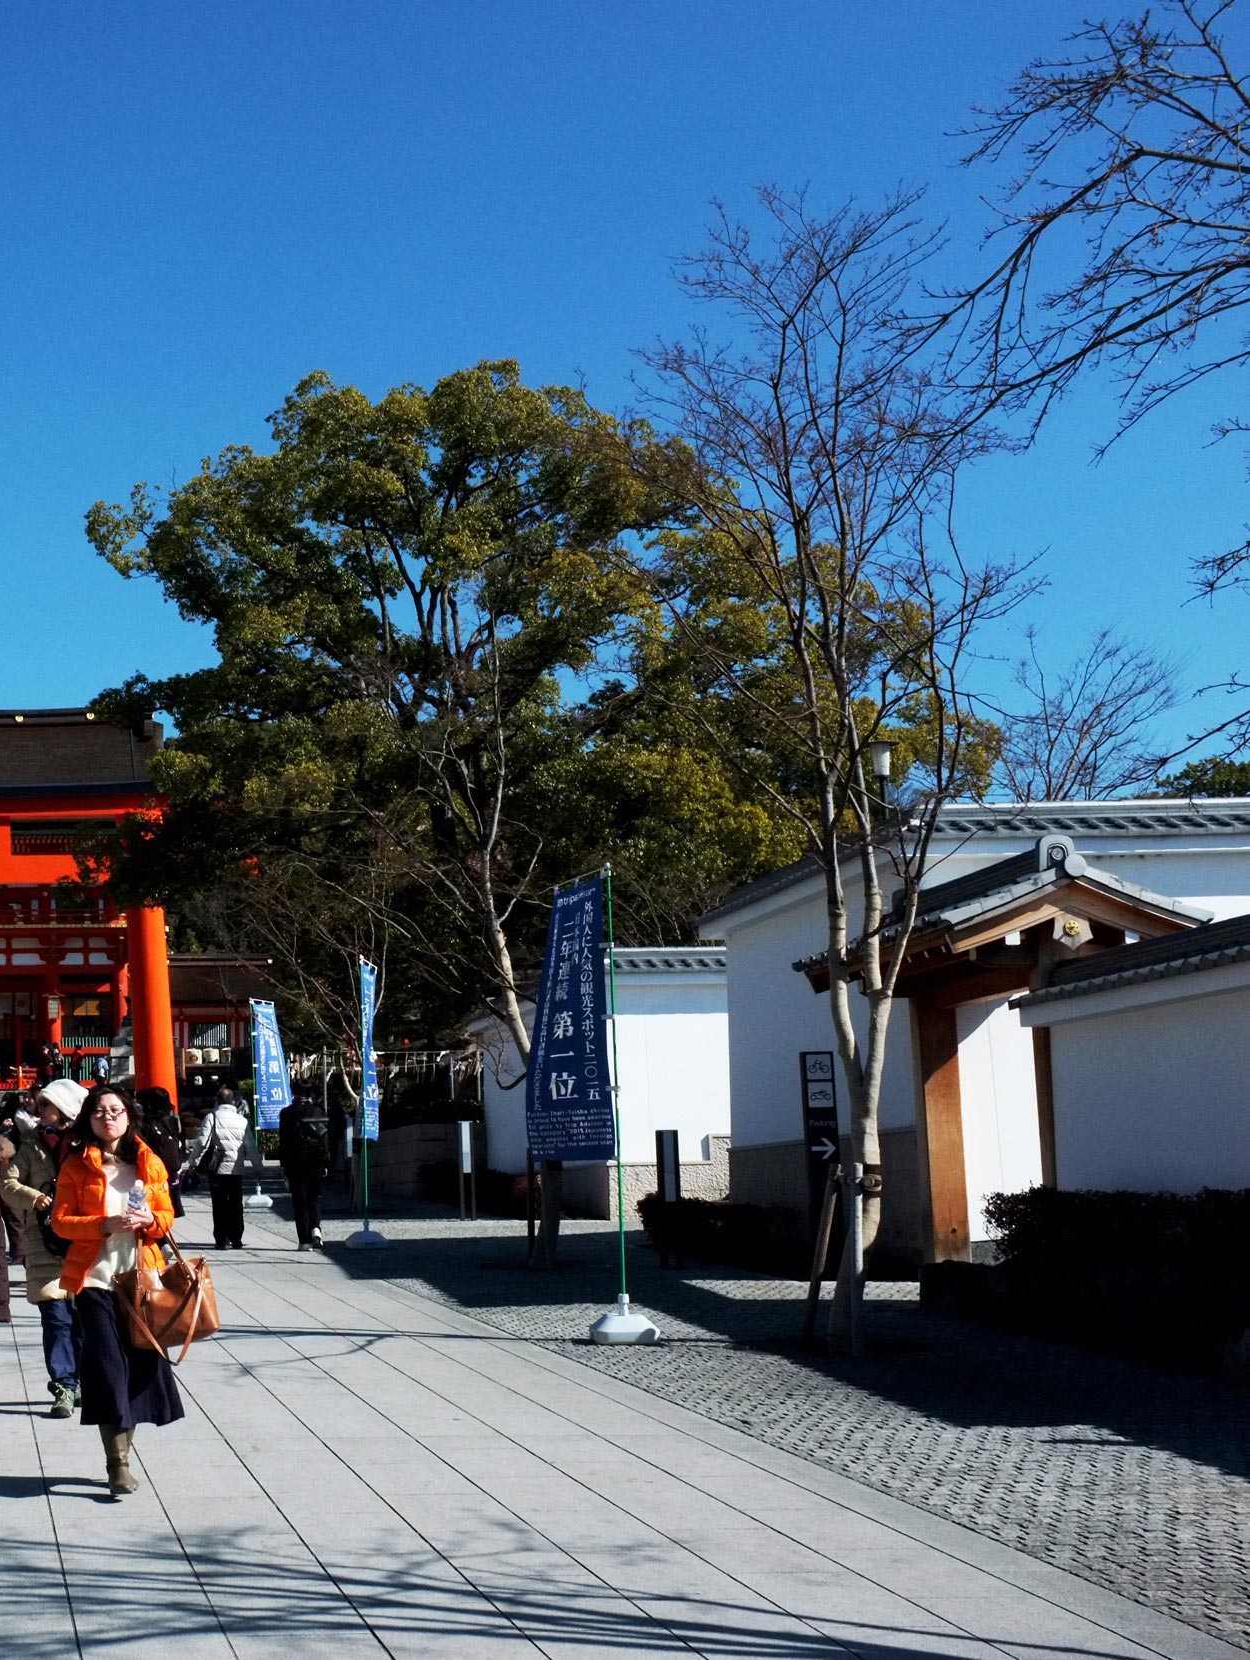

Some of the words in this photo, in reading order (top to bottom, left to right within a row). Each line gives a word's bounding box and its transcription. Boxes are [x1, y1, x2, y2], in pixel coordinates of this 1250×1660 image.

[548, 1011, 579, 1101] 第一位
[809, 1119, 836, 1128] Parking
